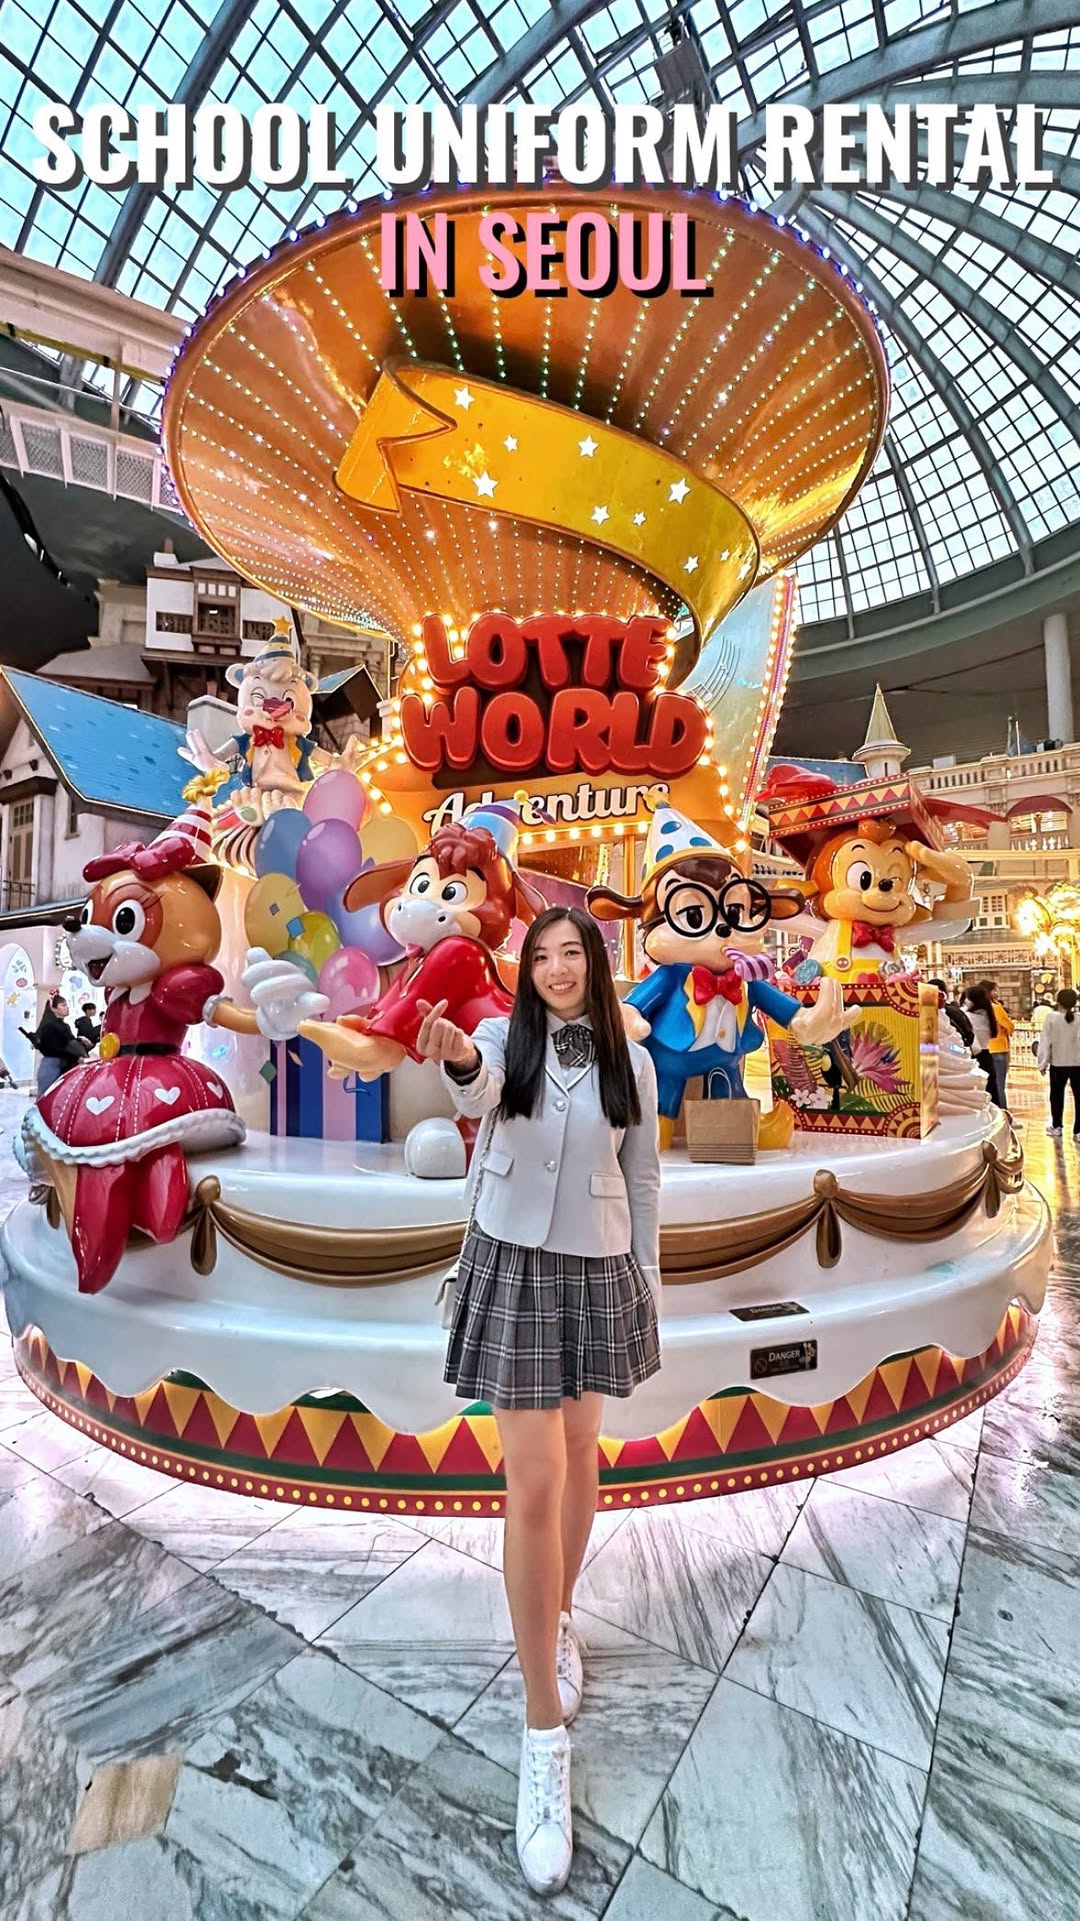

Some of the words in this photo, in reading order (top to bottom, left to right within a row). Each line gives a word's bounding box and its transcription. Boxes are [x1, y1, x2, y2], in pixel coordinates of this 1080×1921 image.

[420, 612, 676, 692] LOTTE
[400, 686, 707, 779] WORLD
[423, 783, 669, 836] Aentur
[768, 1350, 801, 1362] DANGER
